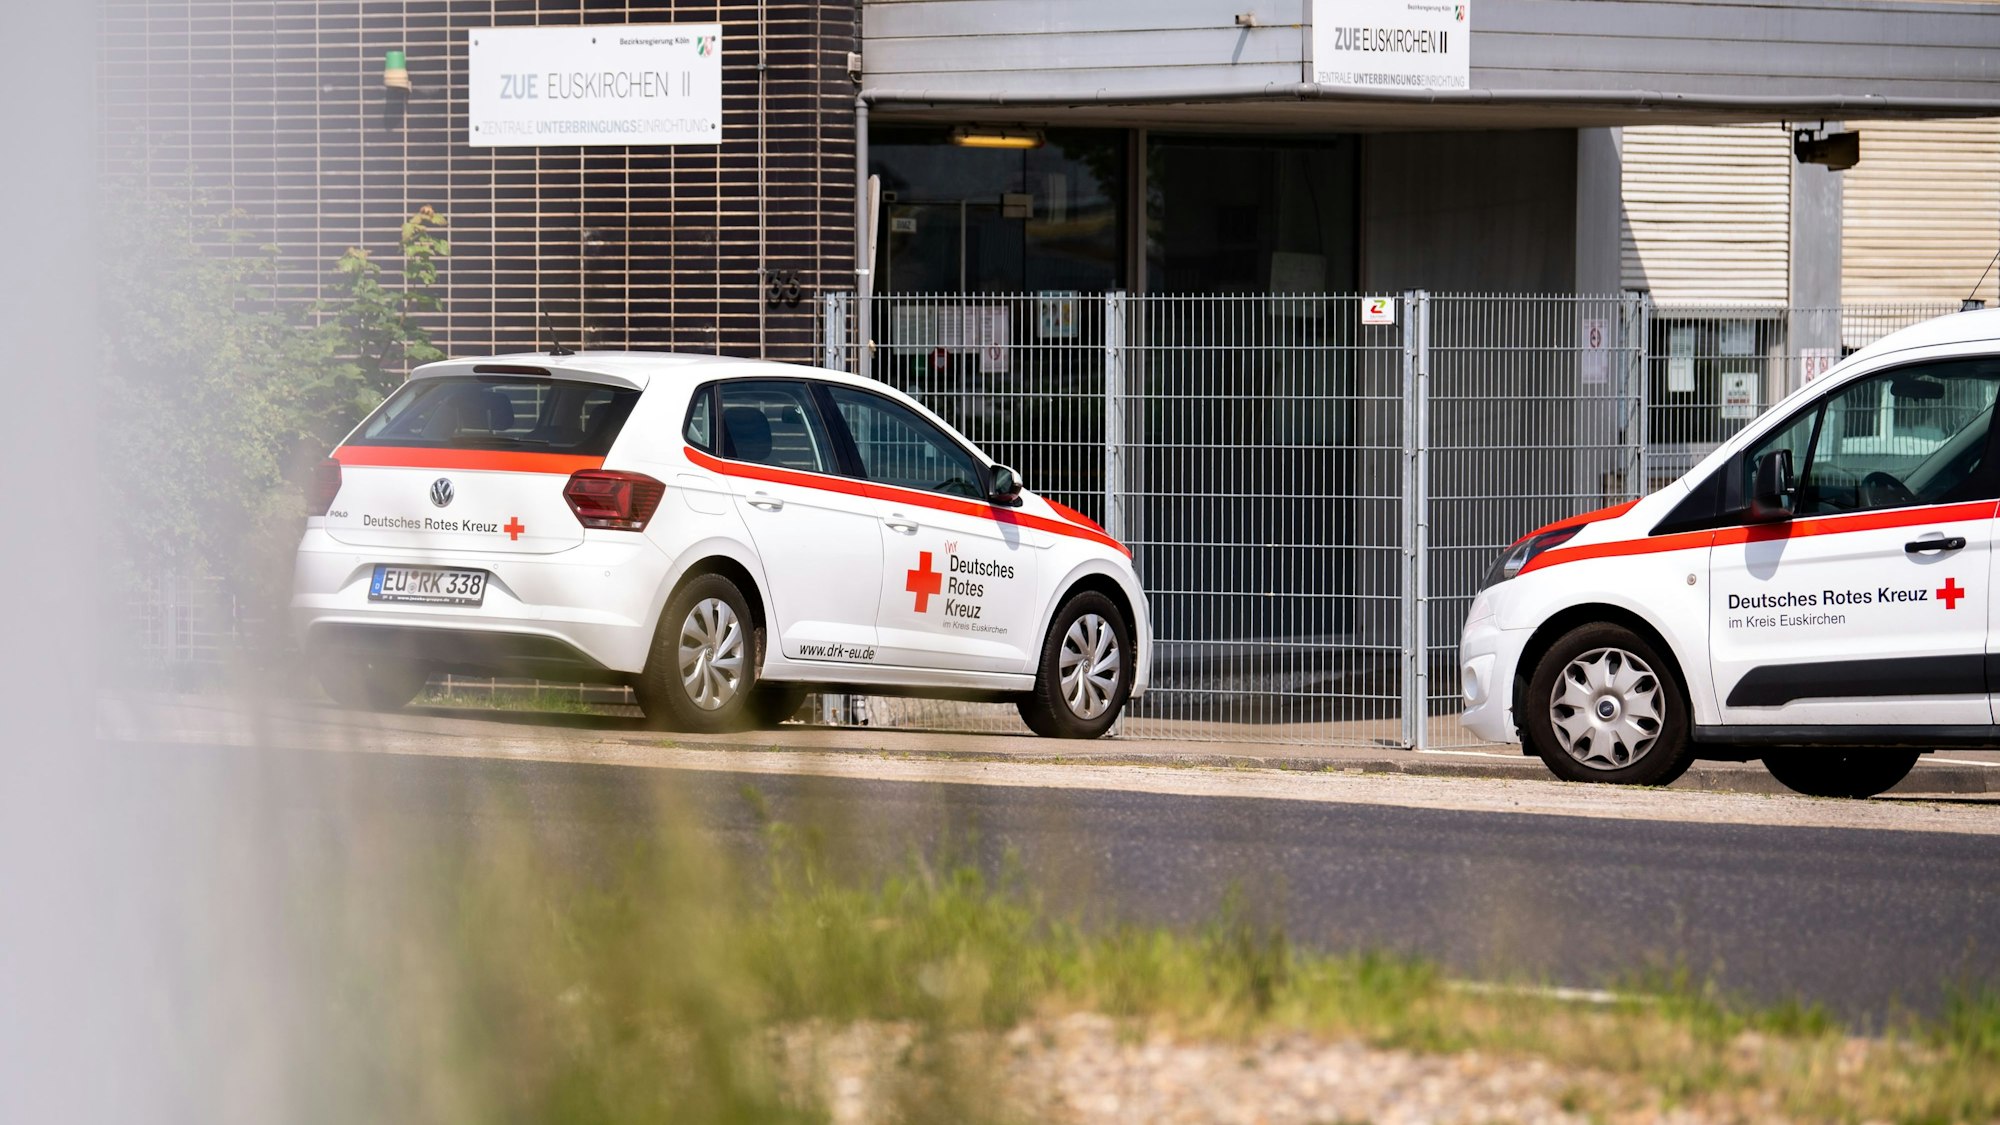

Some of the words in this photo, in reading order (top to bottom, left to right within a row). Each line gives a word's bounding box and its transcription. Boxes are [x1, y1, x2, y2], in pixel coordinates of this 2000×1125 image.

[619, 38, 673, 46] Bezirksregierung
[1335, 27, 1361, 50] ZUE
[1363, 28, 1436, 53] EUSKIRCHEN
[1440, 31, 1448, 53] II
[500, 74, 538, 100] ZUE
[548, 72, 668, 99] EUSKIRCHEN
[682, 71, 691, 97] II
[1318, 71, 1352, 84] ZENTRALE
[1353, 73, 1465, 88] UNTERBRINGUNGSEINRICHTUNG
[482, 121, 533, 135] ZENTRALE
[536, 119, 709, 134] UNTERBRINGUNGSEINRICHTUNG
[330, 510, 349, 518] POLO
[363, 514, 421, 530] Deutsches
[424, 517, 459, 531] Rotes
[462, 519, 498, 533] Kreuz
[950, 554, 1014, 579] Deutsches
[383, 570, 409, 592] EU
[418, 572, 444, 594] RK
[446, 573, 482, 595] 338
[948, 577, 984, 598] Rotes
[1728, 592, 1817, 609] Deutsches
[1823, 589, 1872, 605] Rotes
[1878, 587, 1928, 603] Kreuz
[945, 598, 981, 619] Kreuz
[943, 620, 951, 628] im
[953, 621, 970, 632] Kreis
[971, 624, 1008, 635] Euskirchen
[1728, 616, 1743, 629] im
[1746, 615, 1776, 628] Kreis
[1780, 613, 1846, 627] Euskirchen
[799, 643, 875, 660] www.drk-eu.de
